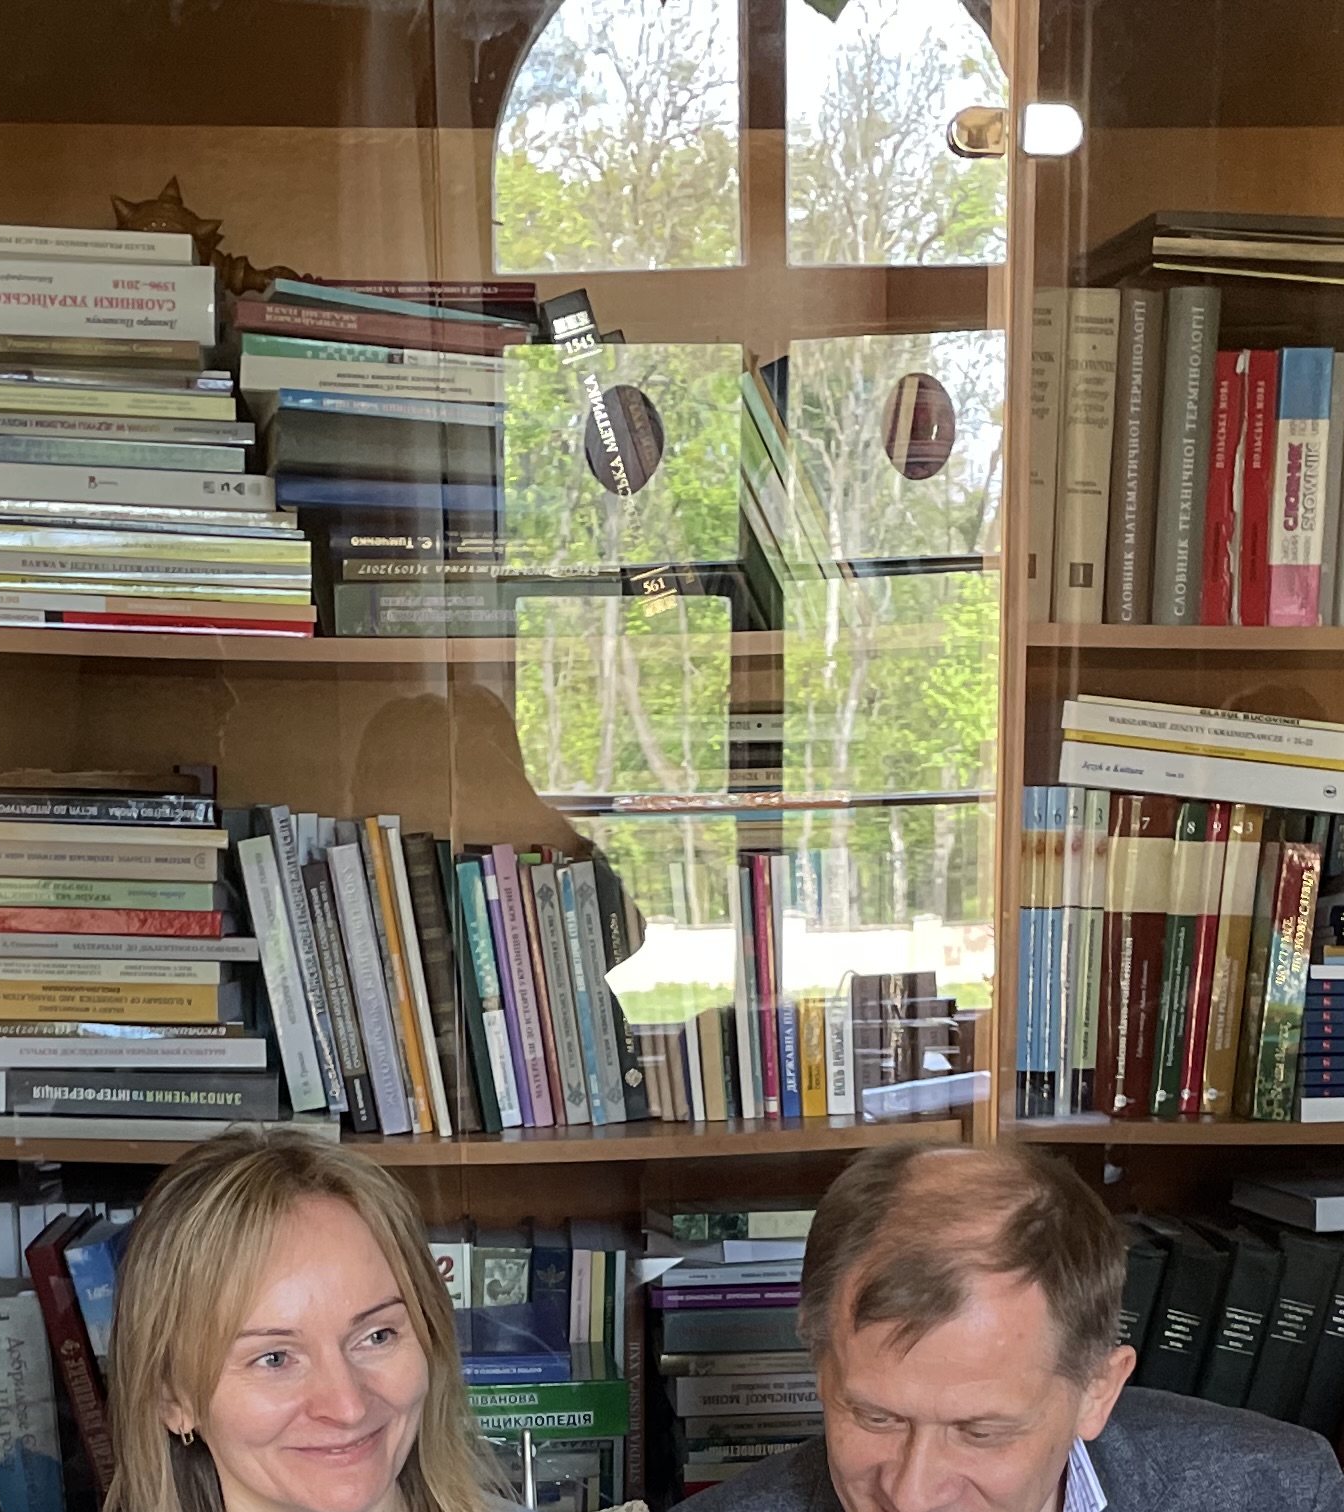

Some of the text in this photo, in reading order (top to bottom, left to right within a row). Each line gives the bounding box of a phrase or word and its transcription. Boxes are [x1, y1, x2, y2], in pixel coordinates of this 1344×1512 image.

[93, 295, 176, 311] СЛОВНИКИ
[563, 333, 596, 354] 1545
[582, 371, 620, 455] МЕТРИКА
[1213, 379, 1230, 469] ПОЛЬСЬКА МОВА
[1251, 379, 1265, 468] ПОЛЬСЬКА МОВА
[1119, 299, 1147, 621] СЛОВНИК МАТЕМАТИЧНОЇ ТЕРМІНОЛОГІЇ
[1171, 305, 1206, 616] СЛОВНИК ТЕХНІЧНОЇ ТЕРМІНОЛОГІЇ
[641, 576, 666, 595] 561
[52, 803, 66, 814] ДО
[68, 804, 97, 815] ВСТУП
[1053, 809, 1062, 825] 6
[1094, 806, 1104, 826] 3
[1140, 815, 1150, 830] 7
[1186, 820, 1196, 835] 8
[142, 996, 184, 1005] GLOSSARY
[518, 987, 532, 1024] ІСТОРІЇ
[526, 1041, 543, 1099] МАТЕРІАЛИ
[781, 1027, 800, 1092] ДЕРЖАВНА
[31, 1082, 242, 1106] ЗАПОЗИЧЕННЯ та ІНТЕРФЕРЕНЦІЯ
[1, 1335, 35, 1431] Добрилове
[627, 1373, 643, 1430] RUSSICA
[480, 1410, 592, 1431] НЦИКЛОПЕДІЯ
[626, 1433, 642, 1483] STUDIA
